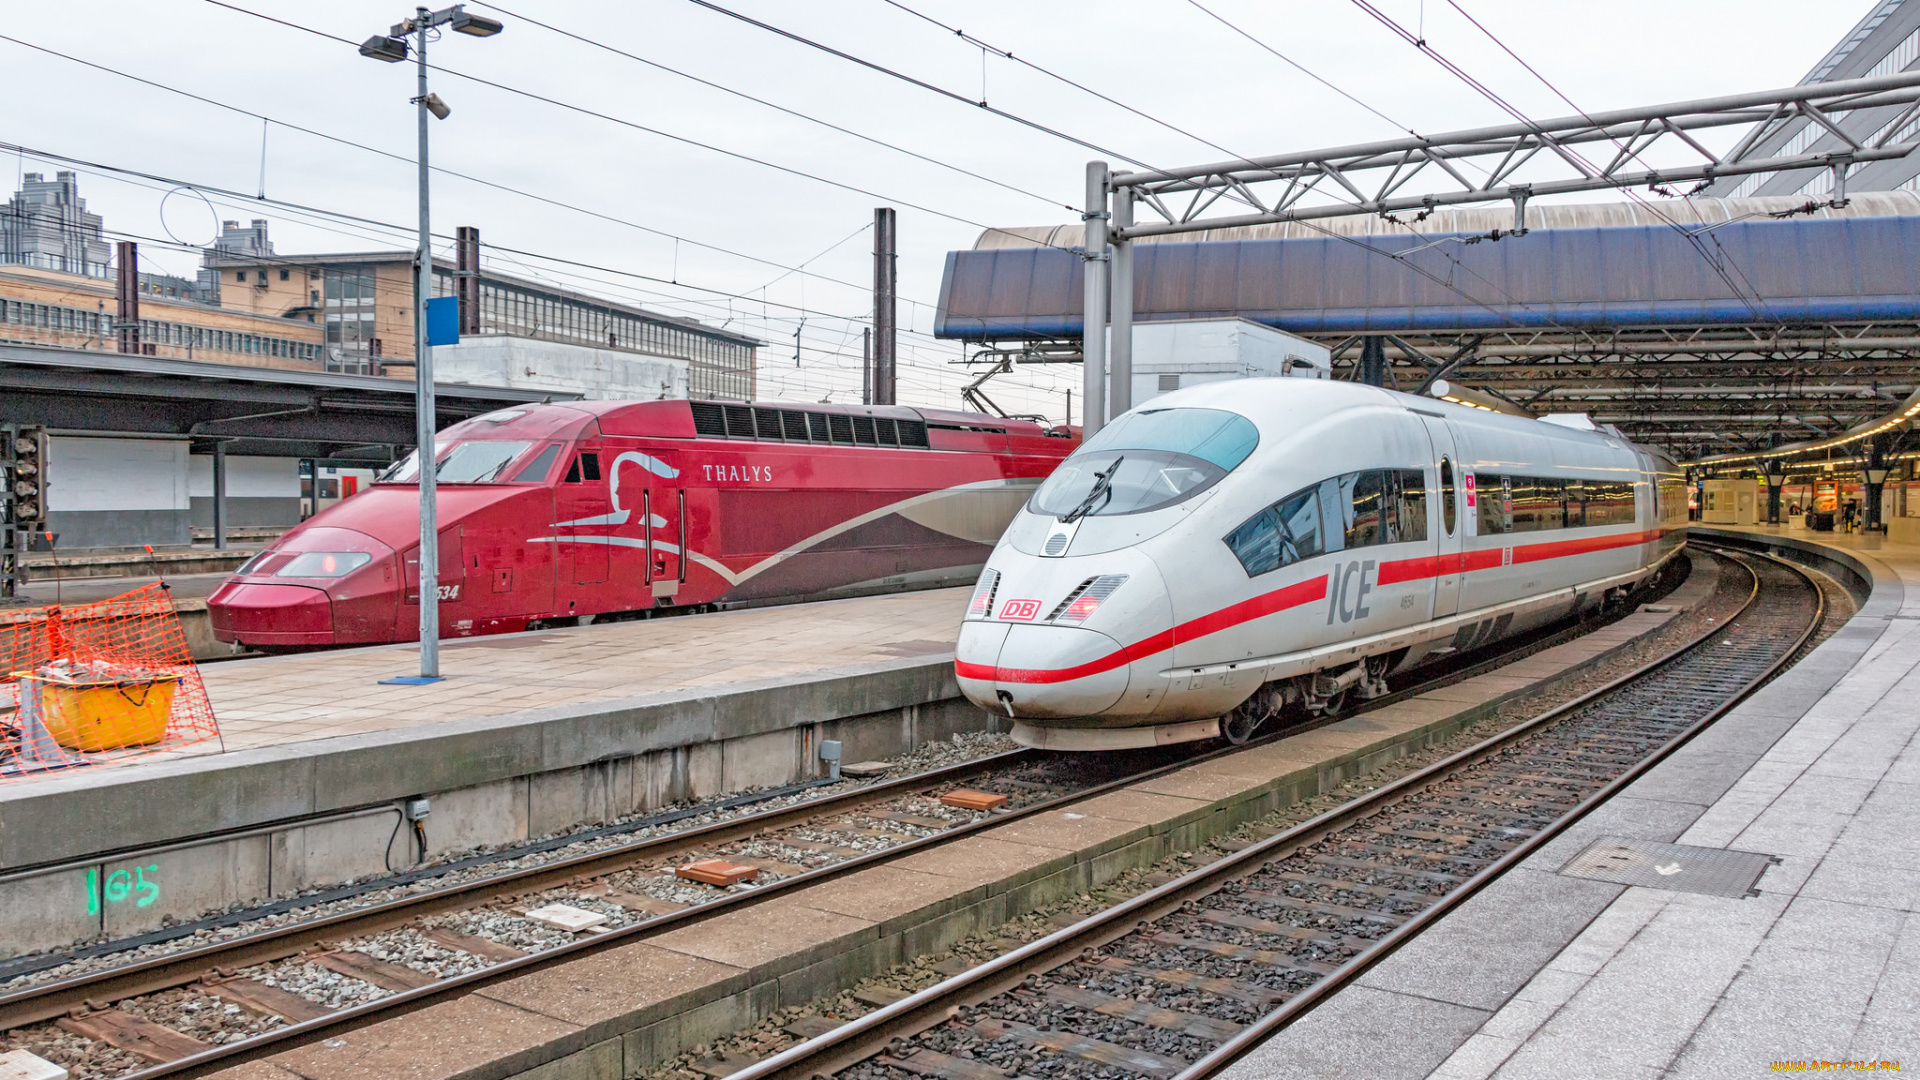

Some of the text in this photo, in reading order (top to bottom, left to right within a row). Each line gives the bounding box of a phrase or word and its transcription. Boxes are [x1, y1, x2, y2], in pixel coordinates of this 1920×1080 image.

[702, 464, 772, 482] THALYS
[1327, 560, 1375, 625] ICE
[1003, 601, 1036, 617] DB
